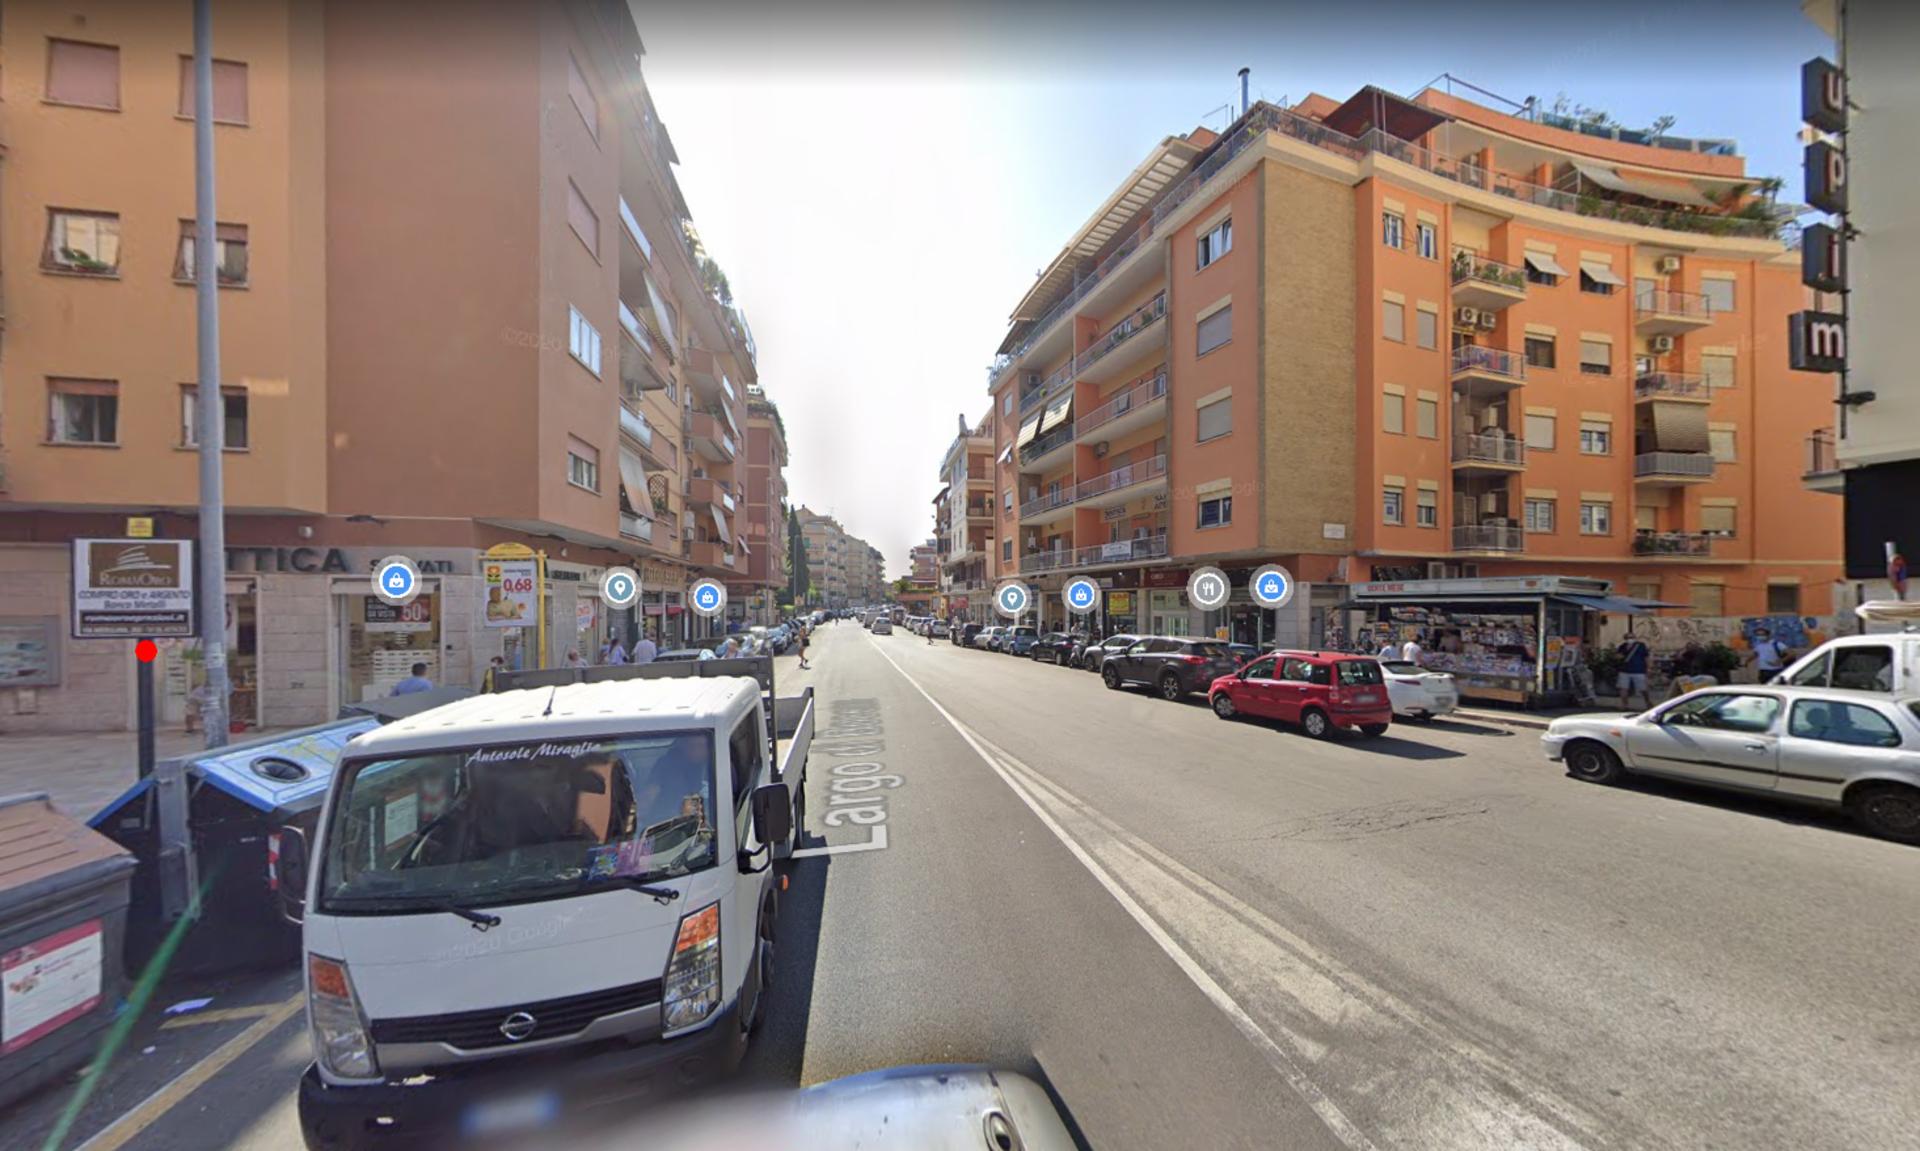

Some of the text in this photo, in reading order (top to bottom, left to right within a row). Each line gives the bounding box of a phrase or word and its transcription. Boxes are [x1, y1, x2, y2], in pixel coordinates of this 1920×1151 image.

[225, 547, 348, 573] TTICA
[79, 590, 119, 600] COMPRO
[120, 590, 139, 600] ORO
[148, 591, 190, 600] ARGENTO
[503, 578, 532, 593] 0,68
[464, 741, 601, 767] Autosole Miraglia
